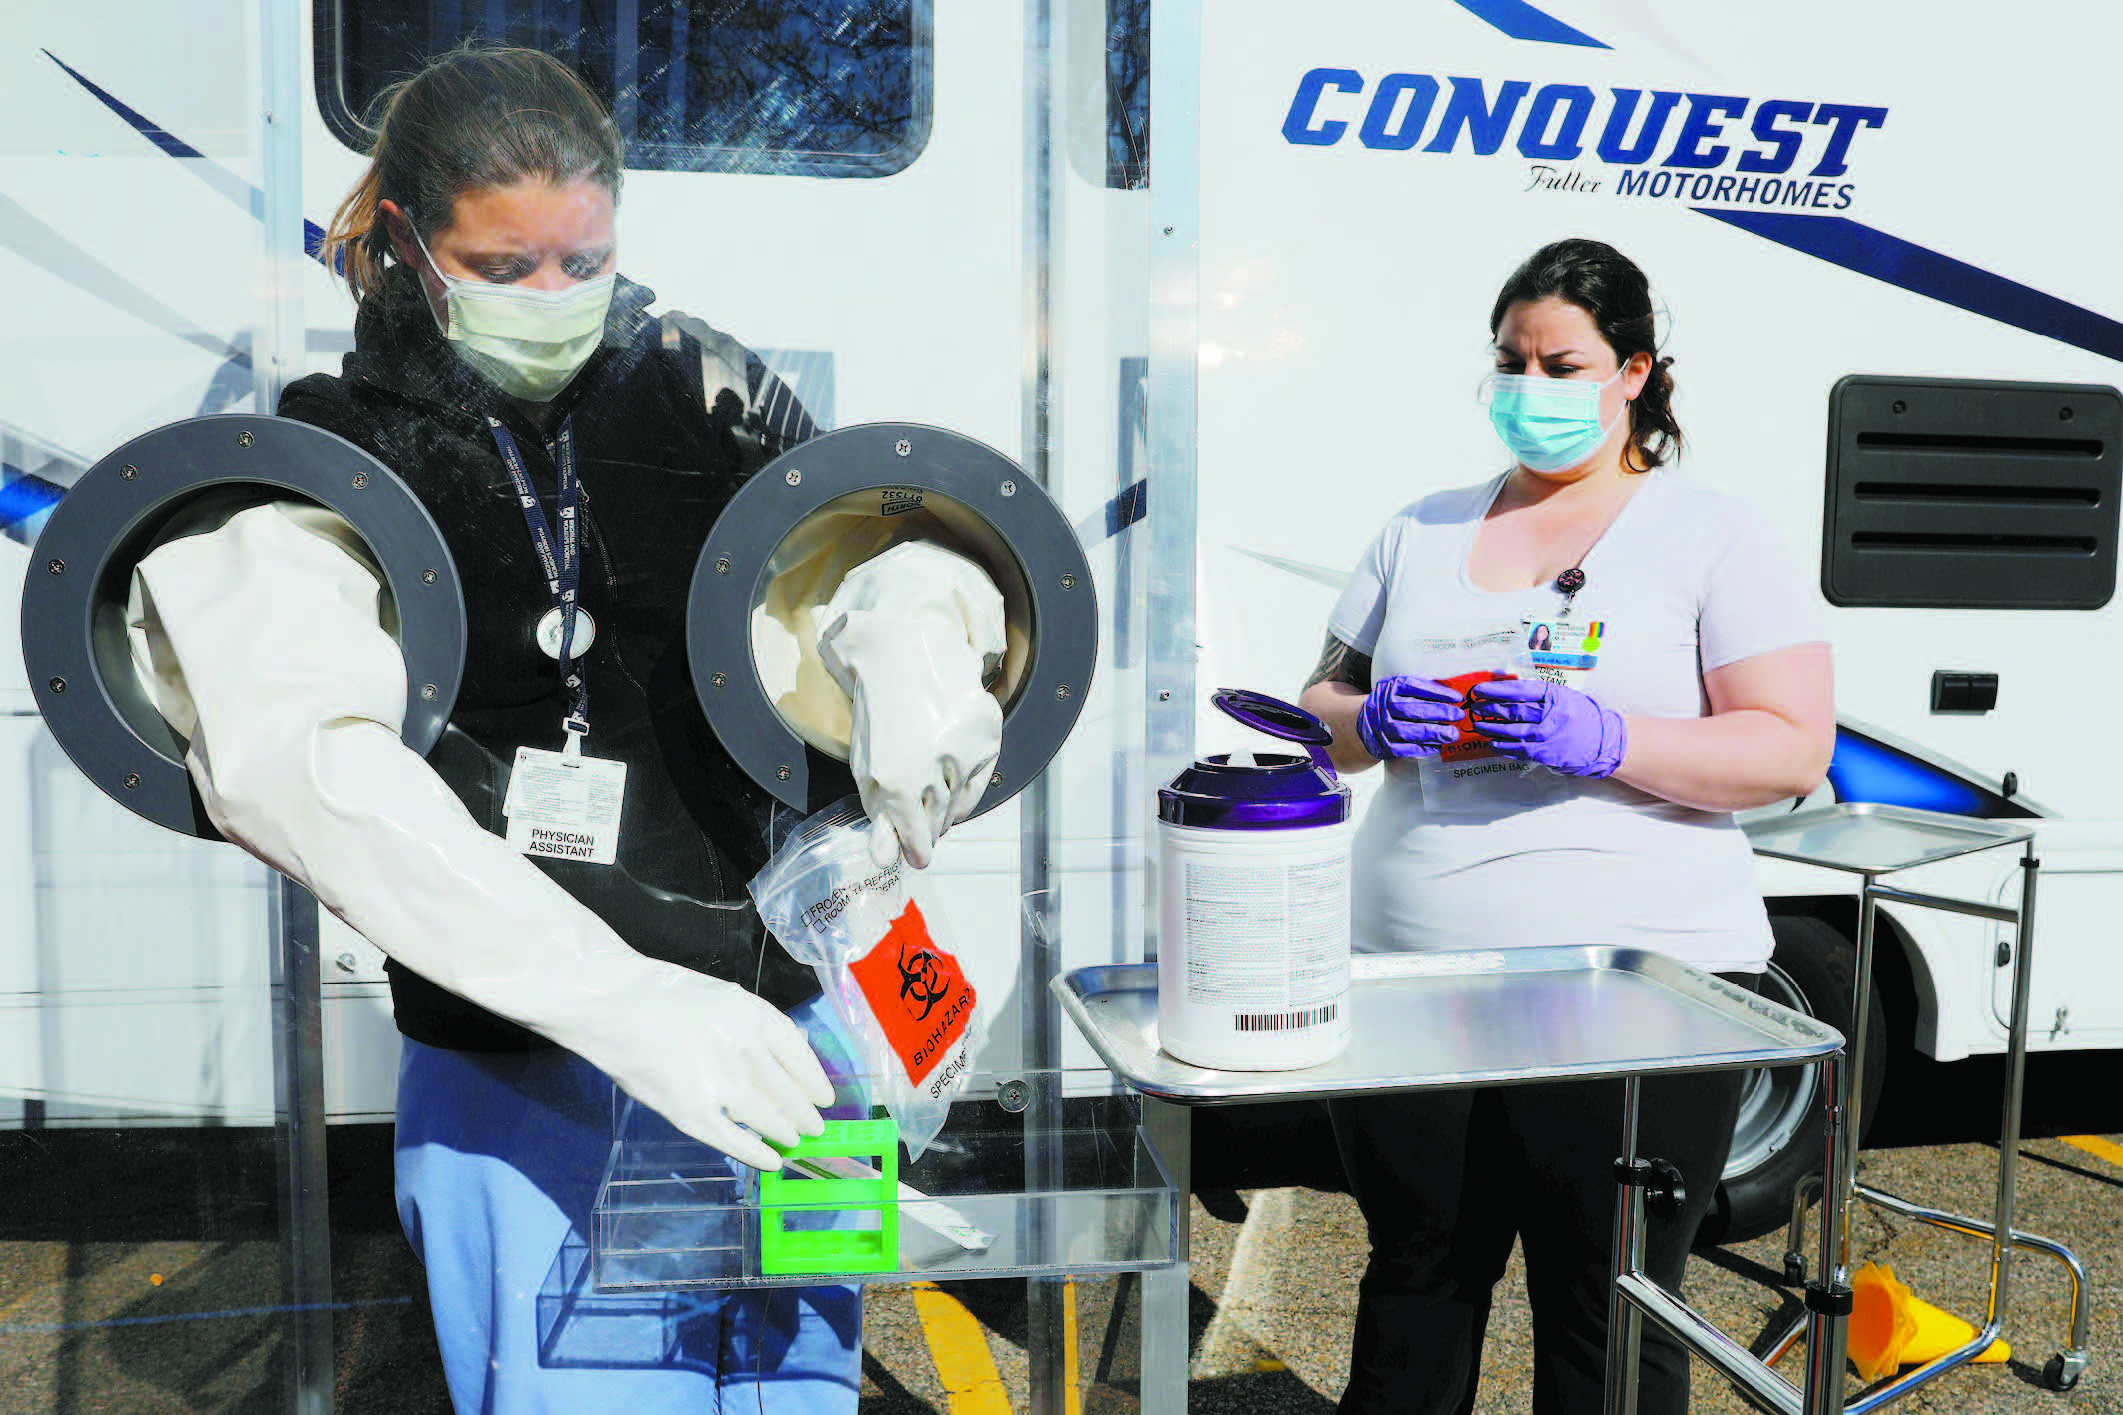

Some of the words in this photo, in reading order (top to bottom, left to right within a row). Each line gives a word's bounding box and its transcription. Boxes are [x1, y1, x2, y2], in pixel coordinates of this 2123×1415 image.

[1281, 67, 1889, 178] CONQUEST
[1523, 165, 1603, 194] Fuller
[1616, 169, 1857, 210] MOTORHOMES
[1453, 763, 1507, 779] SPECIMEN
[531, 828, 595, 846] PHYSICIAN
[529, 841, 595, 858] ASSISTANT
[824, 894, 851, 924] ROOM
